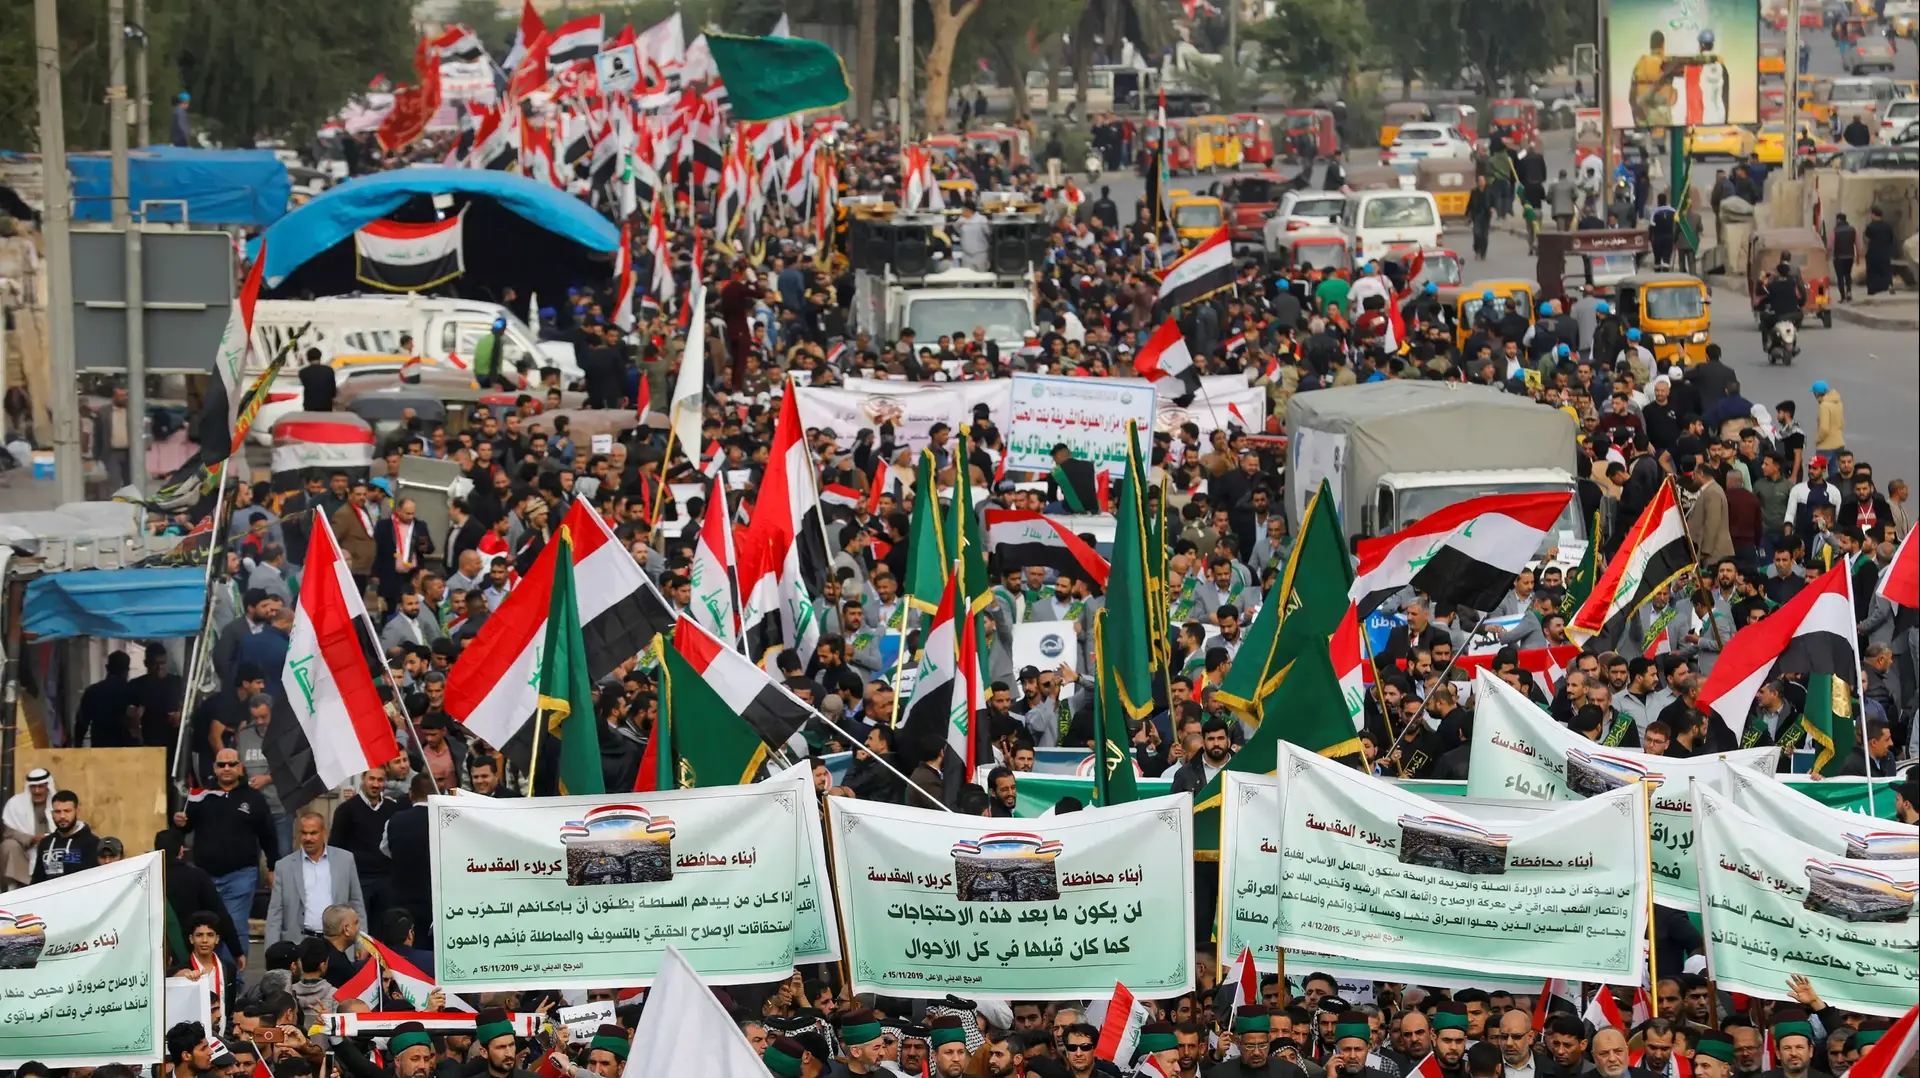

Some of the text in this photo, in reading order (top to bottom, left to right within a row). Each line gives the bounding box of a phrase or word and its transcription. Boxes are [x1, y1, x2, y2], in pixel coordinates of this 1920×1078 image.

[1491, 732, 1537, 758] المقدسة
[1305, 813, 1594, 871] أبناء محافظة كربلاء المقدسة
[466, 846, 757, 876] أبناء محافظة كربلاء المقدسة
[1718, 853, 1764, 882] المقدسة
[867, 864, 1143, 890] أبناء محافظة كربلاء المقدسة
[734, 896, 750, 909] من
[1617, 888, 1630, 899] من
[445, 905, 464, 920] من
[887, 900, 1143, 926] لن يكون ما بعد هذه الاحتجاجات
[1561, 904, 1591, 916] الشعب
[587, 926, 640, 944] بالتسويف
[1307, 921, 1340, 933] 4/12/2015
[94, 928, 119, 949] أبناء
[446, 933, 491, 950] واهمون
[1103, 935, 1130, 955] كما
[905, 938, 961, 959] الأحوال
[996, 938, 1020, 967] في
[1024, 937, 1063, 962] قبلها
[1069, 937, 1099, 962] كان
[480, 963, 519, 974] 15/11/2019
[1782, 951, 1851, 971] محاكمتهم
[888, 971, 924, 980] 15/11/2019
[67, 982, 75, 995] لا
[80, 1003, 93, 1021] في
[95, 1003, 122, 1016] ستعود
[563, 1009, 612, 1025] مرجعيتنا
